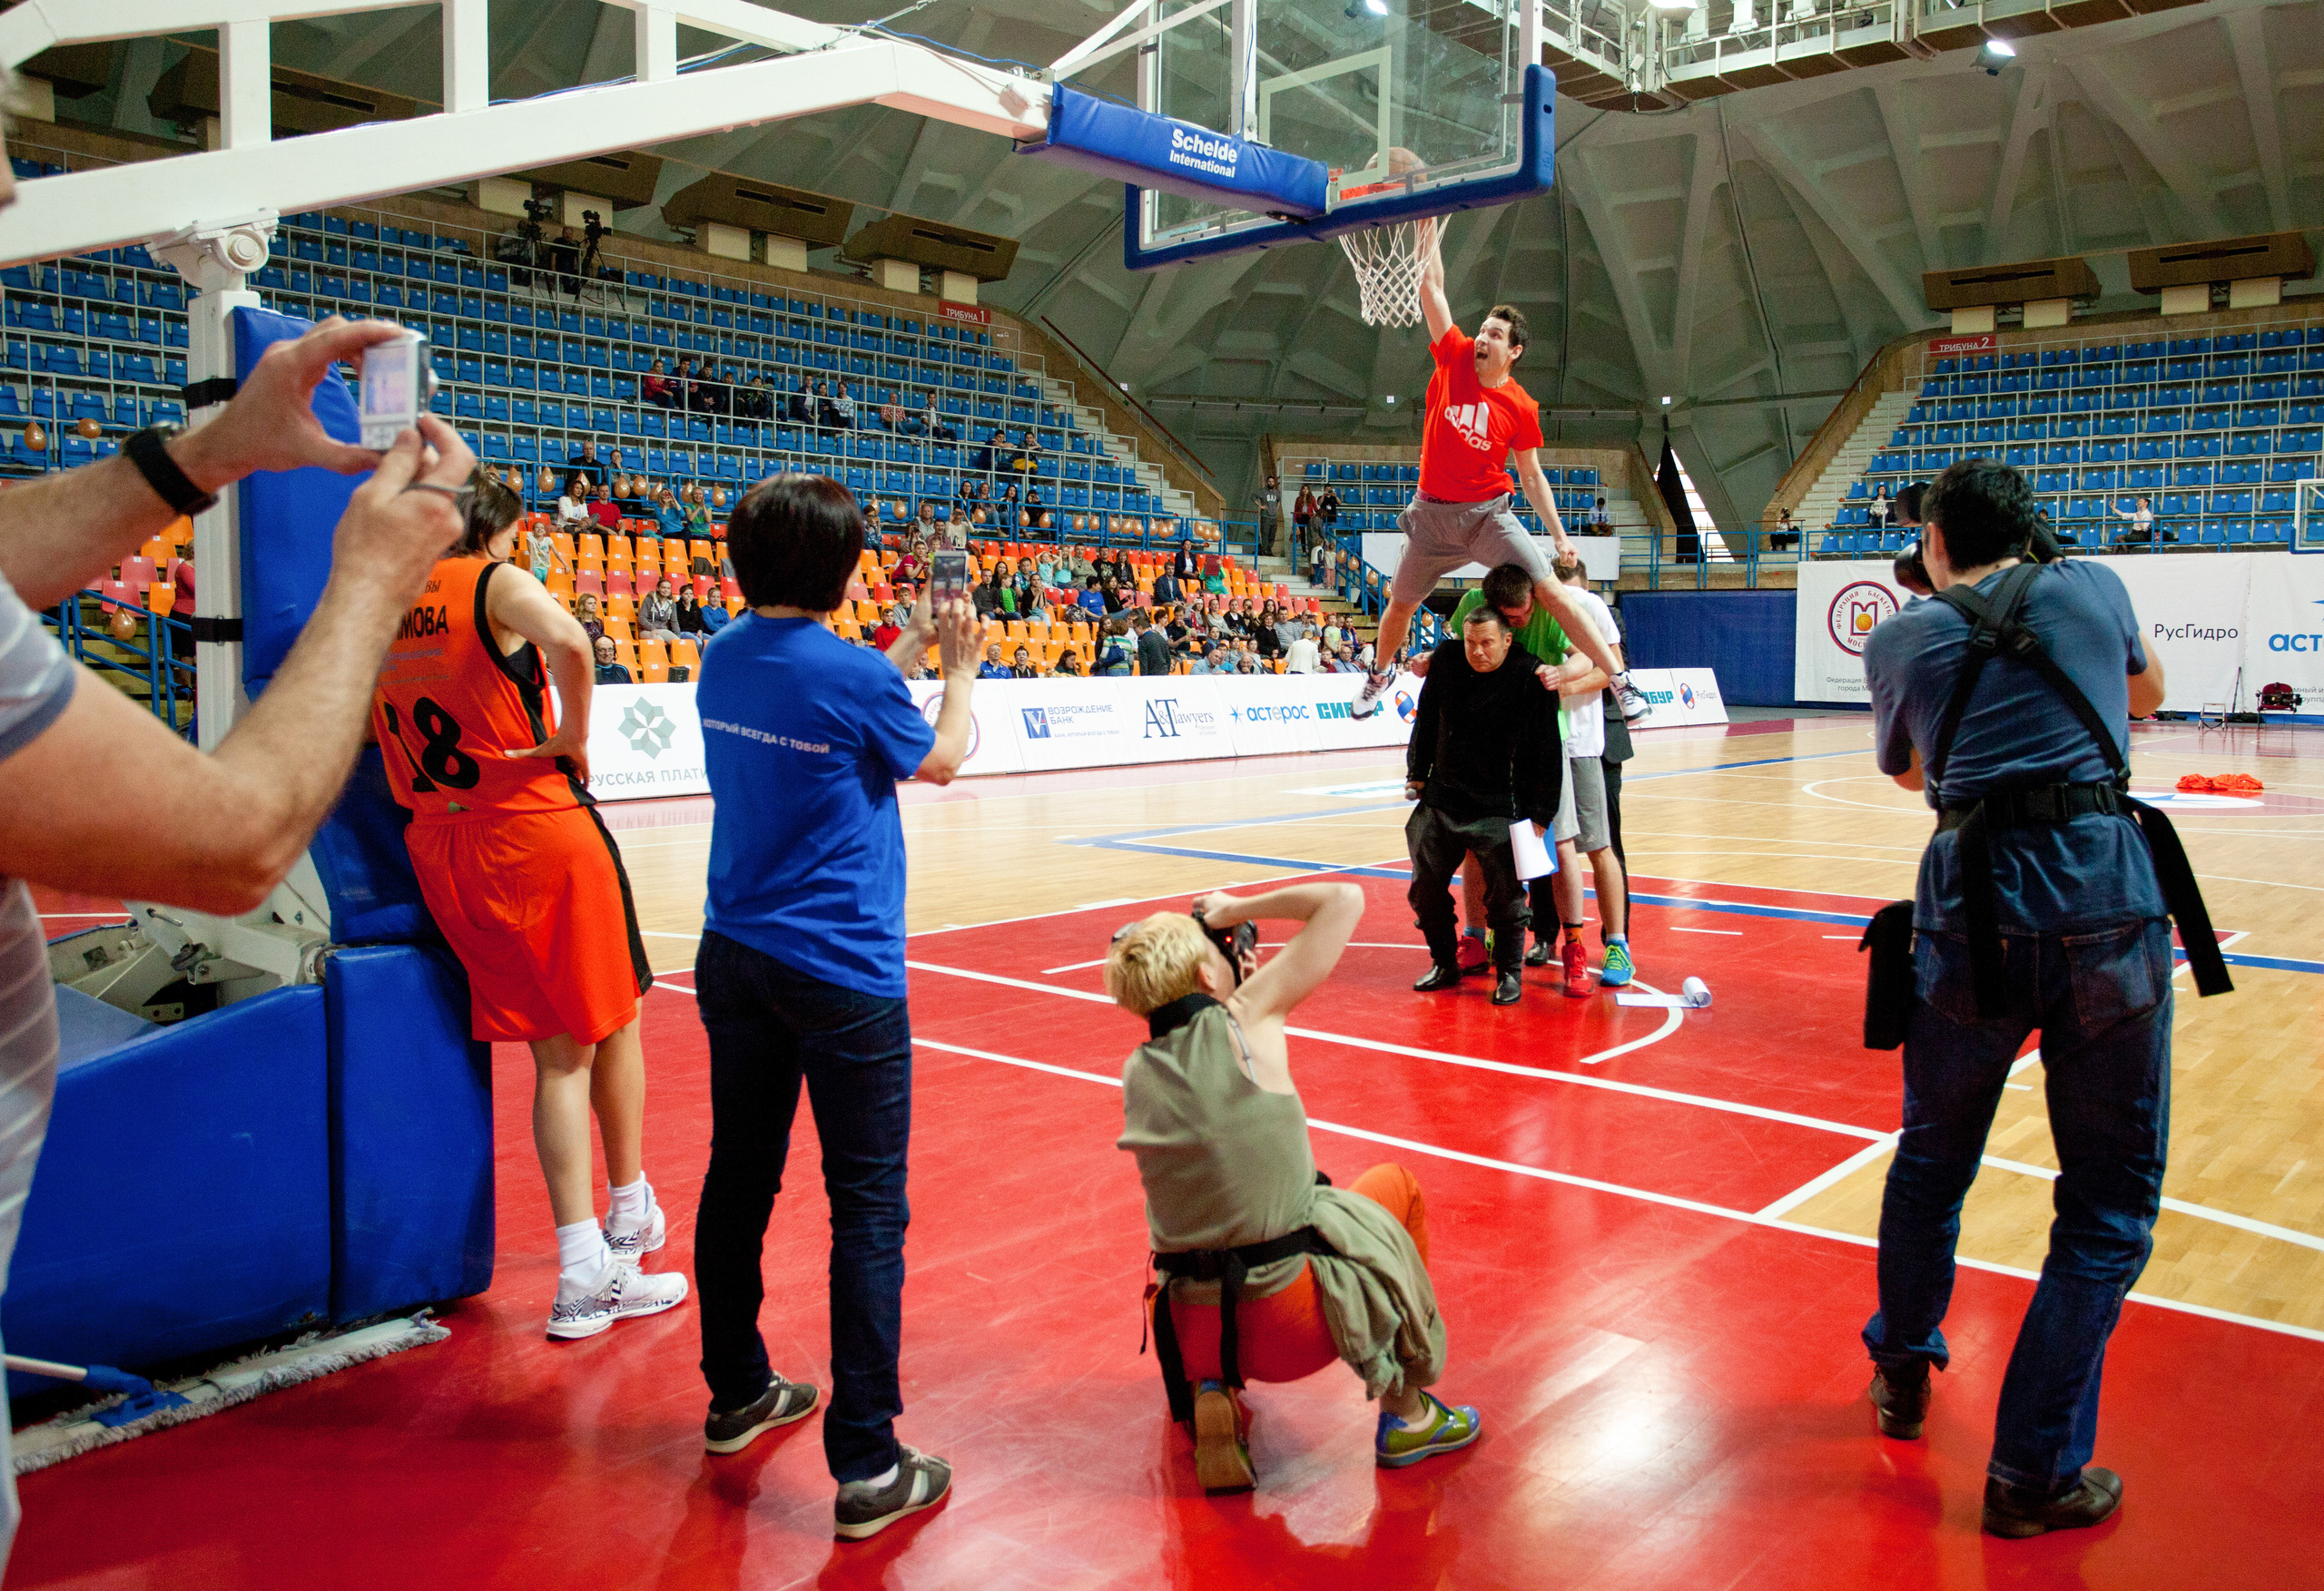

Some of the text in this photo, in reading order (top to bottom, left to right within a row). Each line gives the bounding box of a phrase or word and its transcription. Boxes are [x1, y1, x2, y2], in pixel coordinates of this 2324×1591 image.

[1171, 129, 1237, 163] Schelde
[1169, 150, 1236, 178] International
[946, 308, 985, 322] ТРИБУНА 1
[1939, 337, 1989, 352] ТРИБУНА 2
[424, 580, 441, 594] ВЫ
[1867, 590, 1892, 617] БАСКЕТБ
[397, 604, 449, 641] МОВА
[2154, 624, 2239, 641] РусГидро
[2268, 633, 2324, 652] аст
[1827, 676, 1862, 684] Федерация
[1641, 691, 1674, 704] БУР
[1048, 704, 1114, 715] ВОЗРОЖДЕНИЕ
[1172, 709, 1215, 728] lawyers
[1246, 705, 1309, 723] астерос
[1050, 716, 1074, 724] БАНК
[384, 697, 480, 792] 18
[703, 718, 830, 753] КОТОРЫЙ ВСЕГДА С ТОБОЙ
